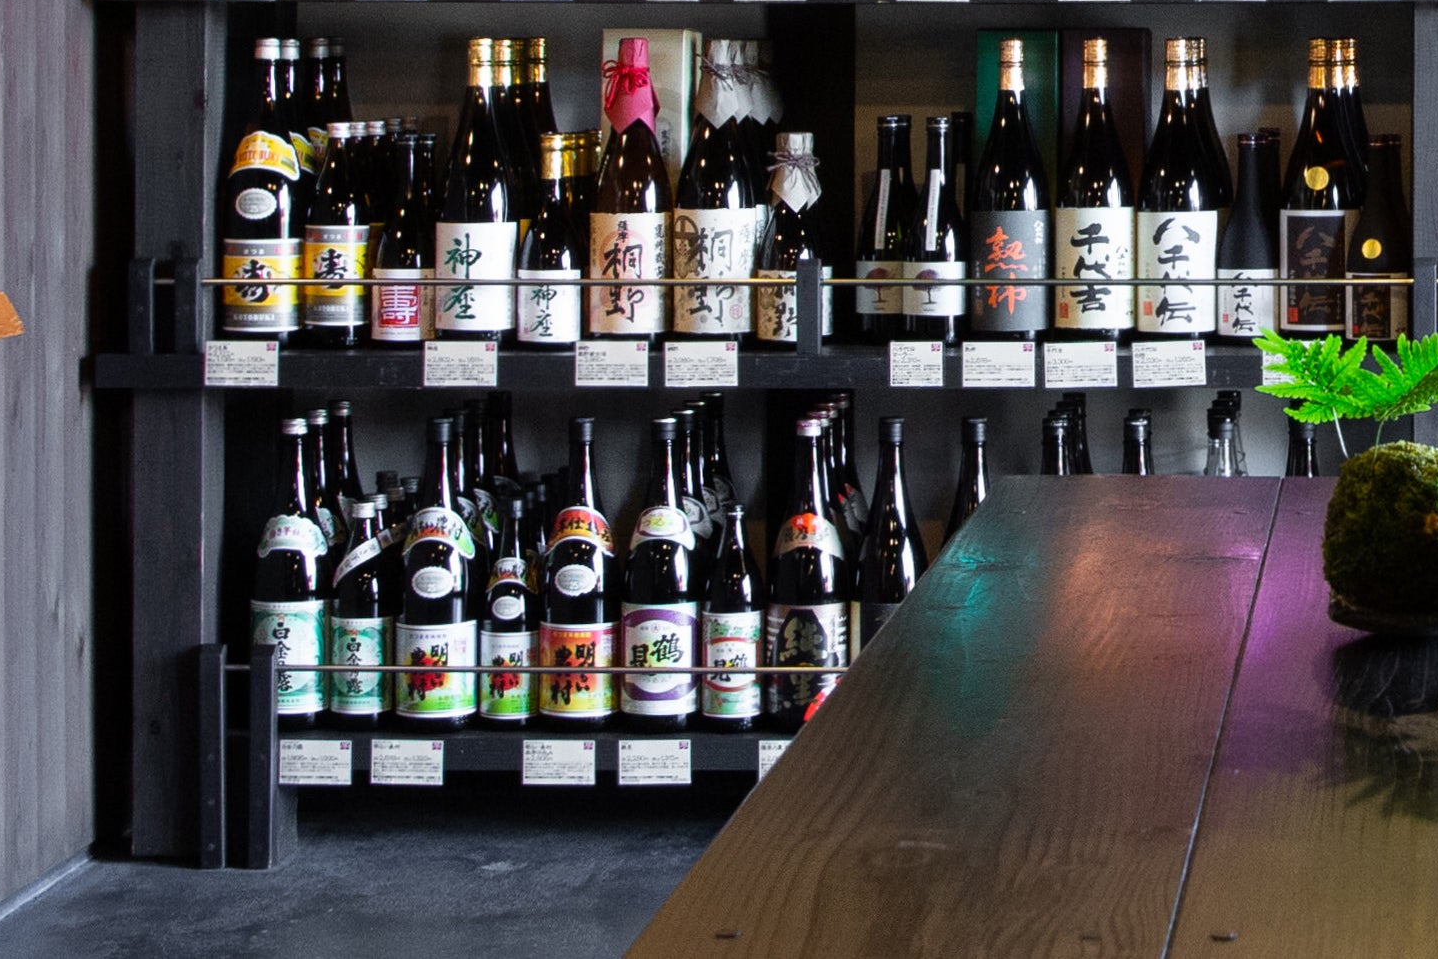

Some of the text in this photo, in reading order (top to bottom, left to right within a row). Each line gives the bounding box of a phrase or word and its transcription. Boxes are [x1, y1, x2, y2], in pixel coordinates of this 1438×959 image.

[444, 232, 482, 321] 神座
[529, 283, 558, 338] 神座
[983, 225, 1029, 315] 熟柿
[1069, 222, 1114, 314] 千代吉
